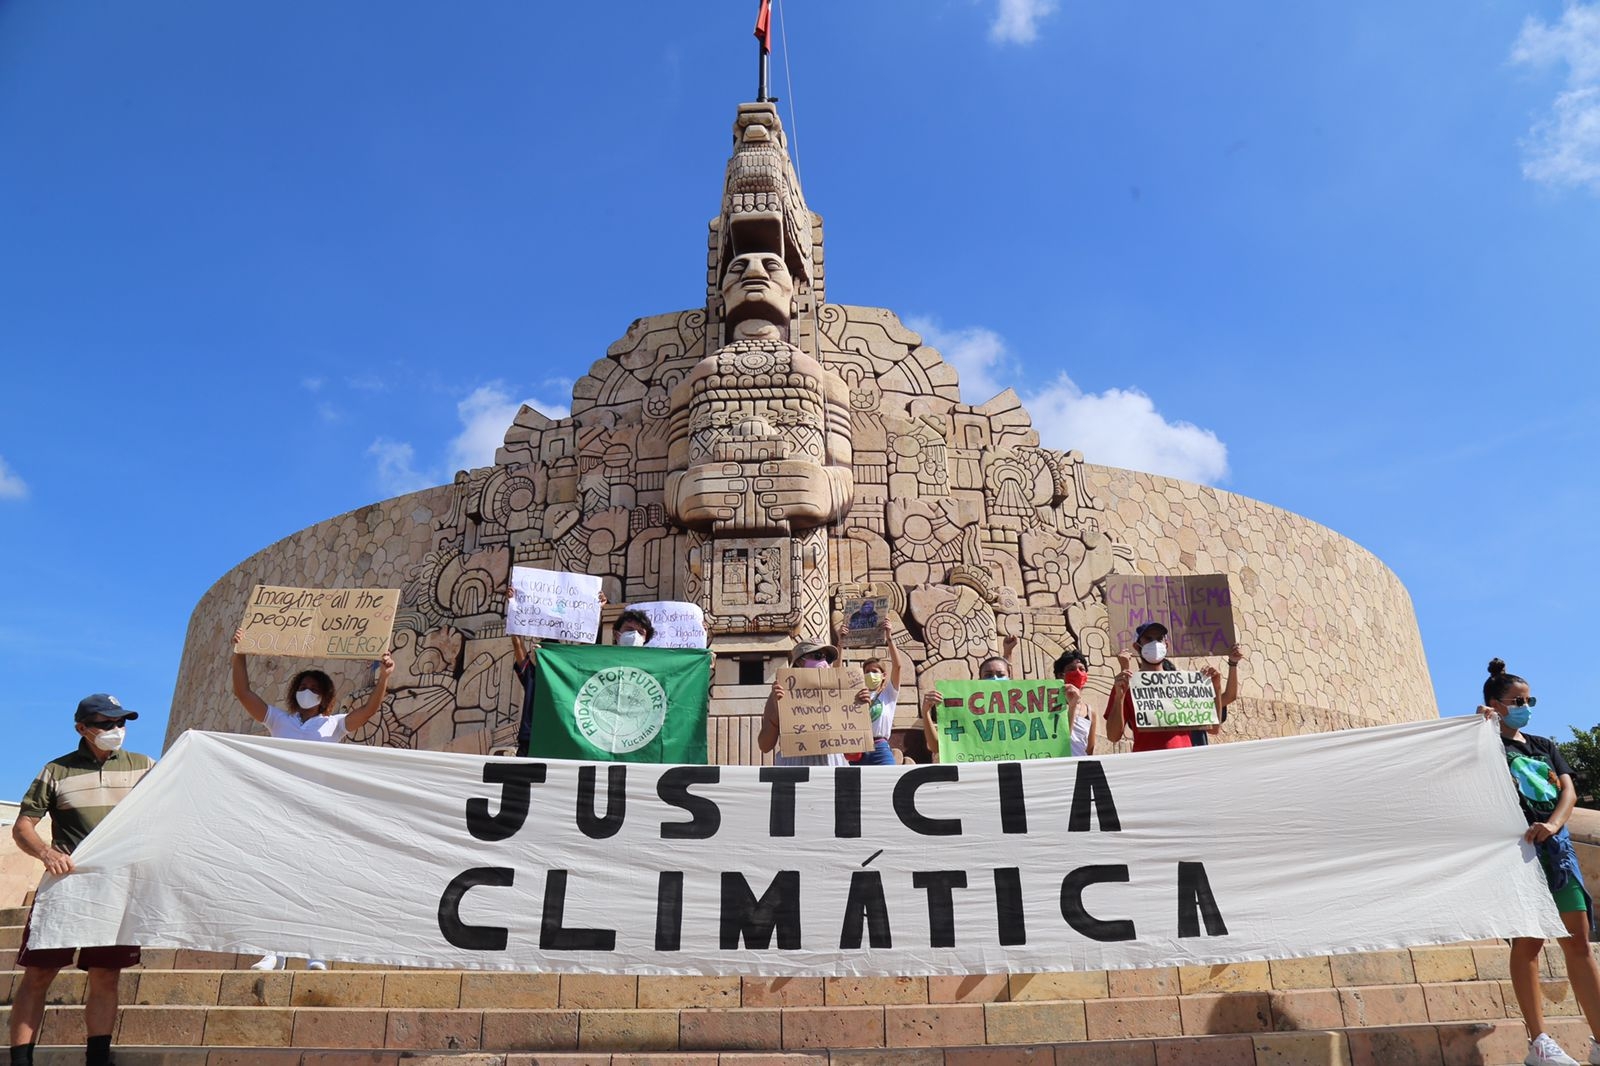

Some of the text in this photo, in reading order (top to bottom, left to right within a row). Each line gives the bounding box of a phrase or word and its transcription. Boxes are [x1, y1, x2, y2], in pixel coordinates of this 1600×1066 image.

[520, 579, 562, 595] Cuando
[1108, 583, 1232, 608] CAPITALISMO
[254, 587, 383, 613] Imagine all the
[246, 612, 370, 636] people using
[1190, 609, 1220, 627] AL
[241, 632, 390, 653] SOLAR ENERGY
[785, 675, 820, 699] Paren
[828, 678, 842, 699] el
[1141, 672, 1203, 686] SOMOS LA
[578, 670, 663, 737] FRIDAYS FOR FUTURE
[791, 703, 863, 720] mundo que
[968, 686, 1063, 715] CARNE
[1136, 698, 1216, 710] PARA Salvar
[793, 722, 856, 734] se nos va
[973, 713, 1060, 742] VIDA!
[1154, 709, 1215, 726] Planeta
[795, 734, 863, 751] a acabar
[466, 761, 1121, 841] JUSTICIA
[438, 849, 1229, 950] CLIMÁTICA
